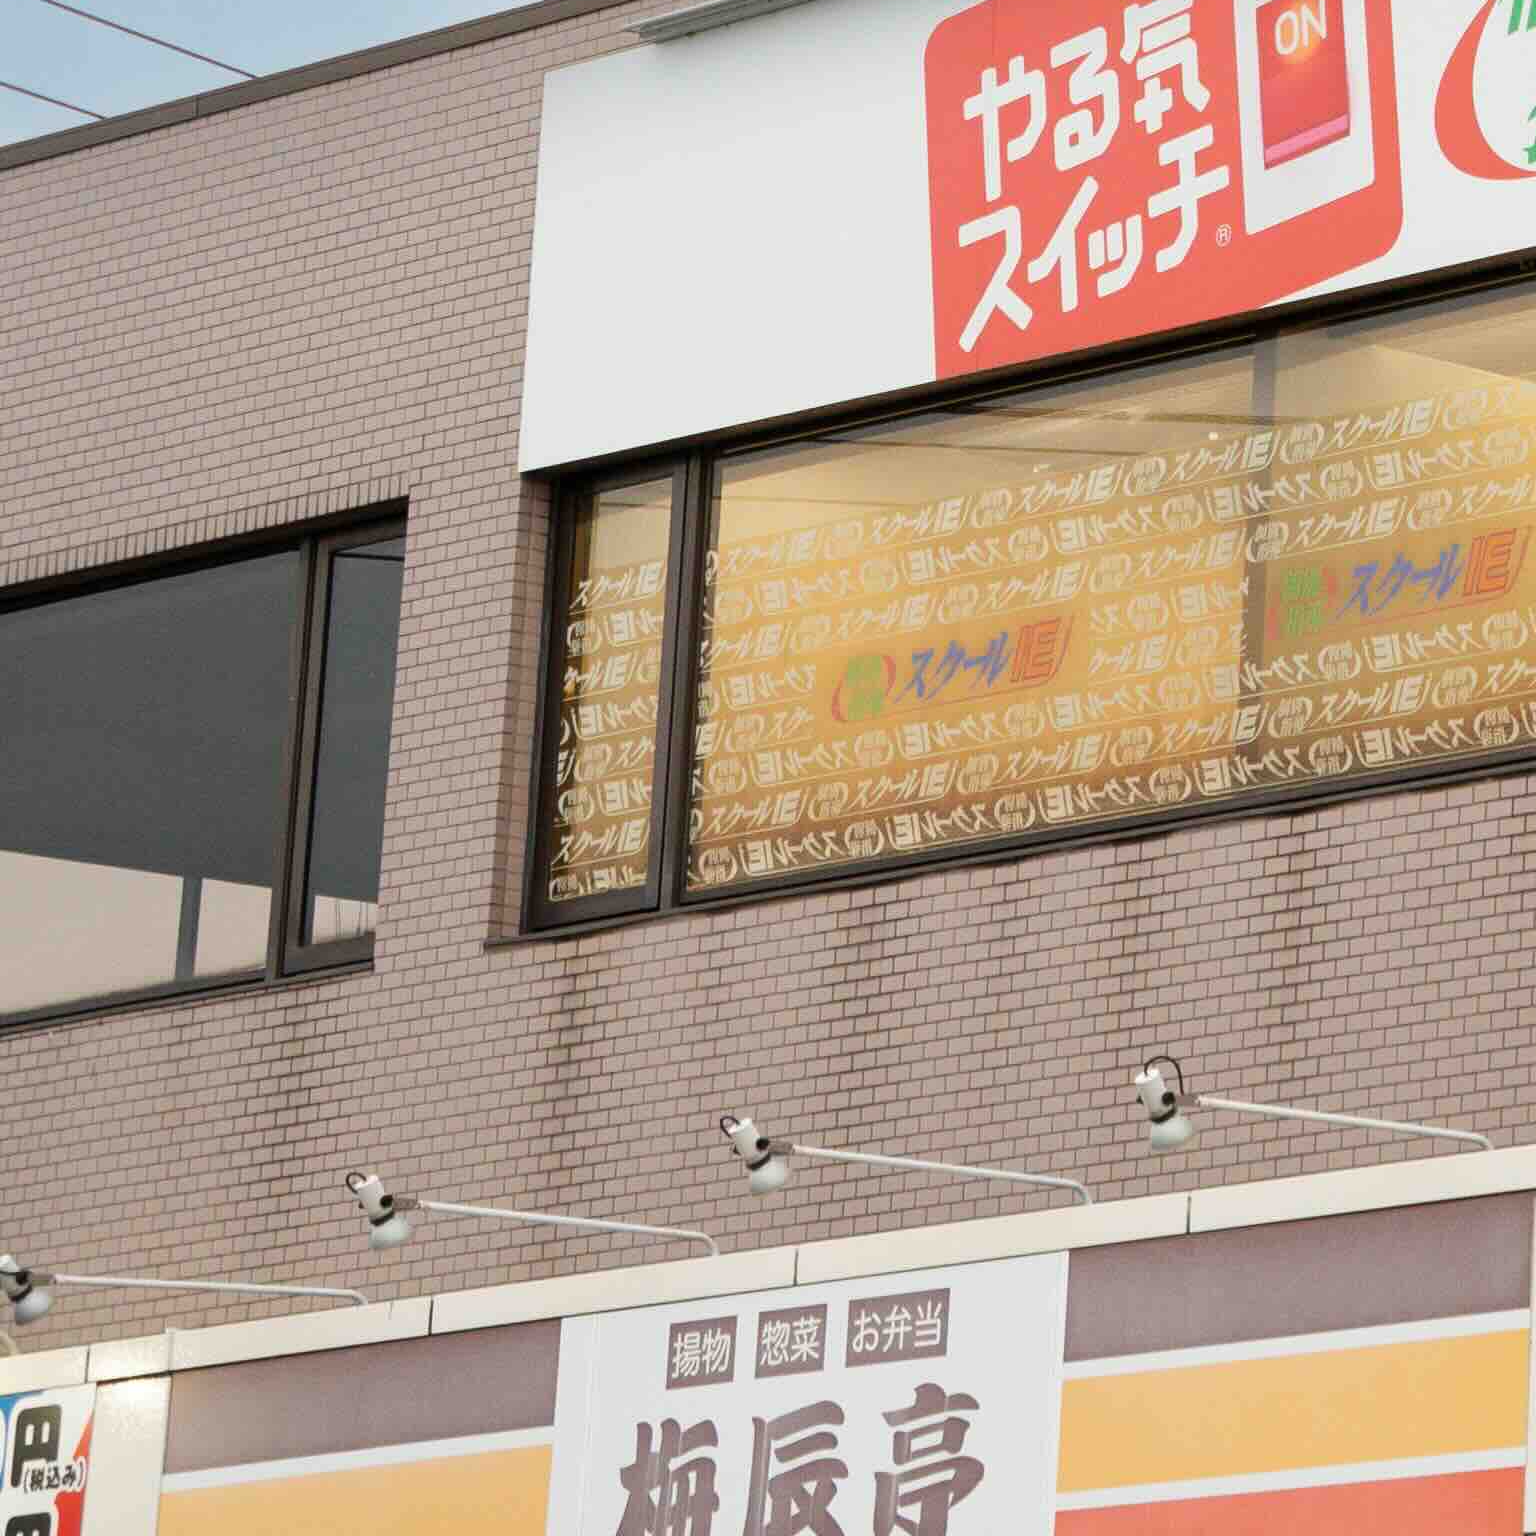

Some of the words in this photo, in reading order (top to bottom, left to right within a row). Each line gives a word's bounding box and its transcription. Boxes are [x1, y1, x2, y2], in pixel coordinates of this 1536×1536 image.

[958, 127, 1230, 353] スイッチ
[671, 1324, 732, 1379] 揚物
[760, 1317, 823, 1366] 惣菜
[851, 1301, 943, 1354] お弁当
